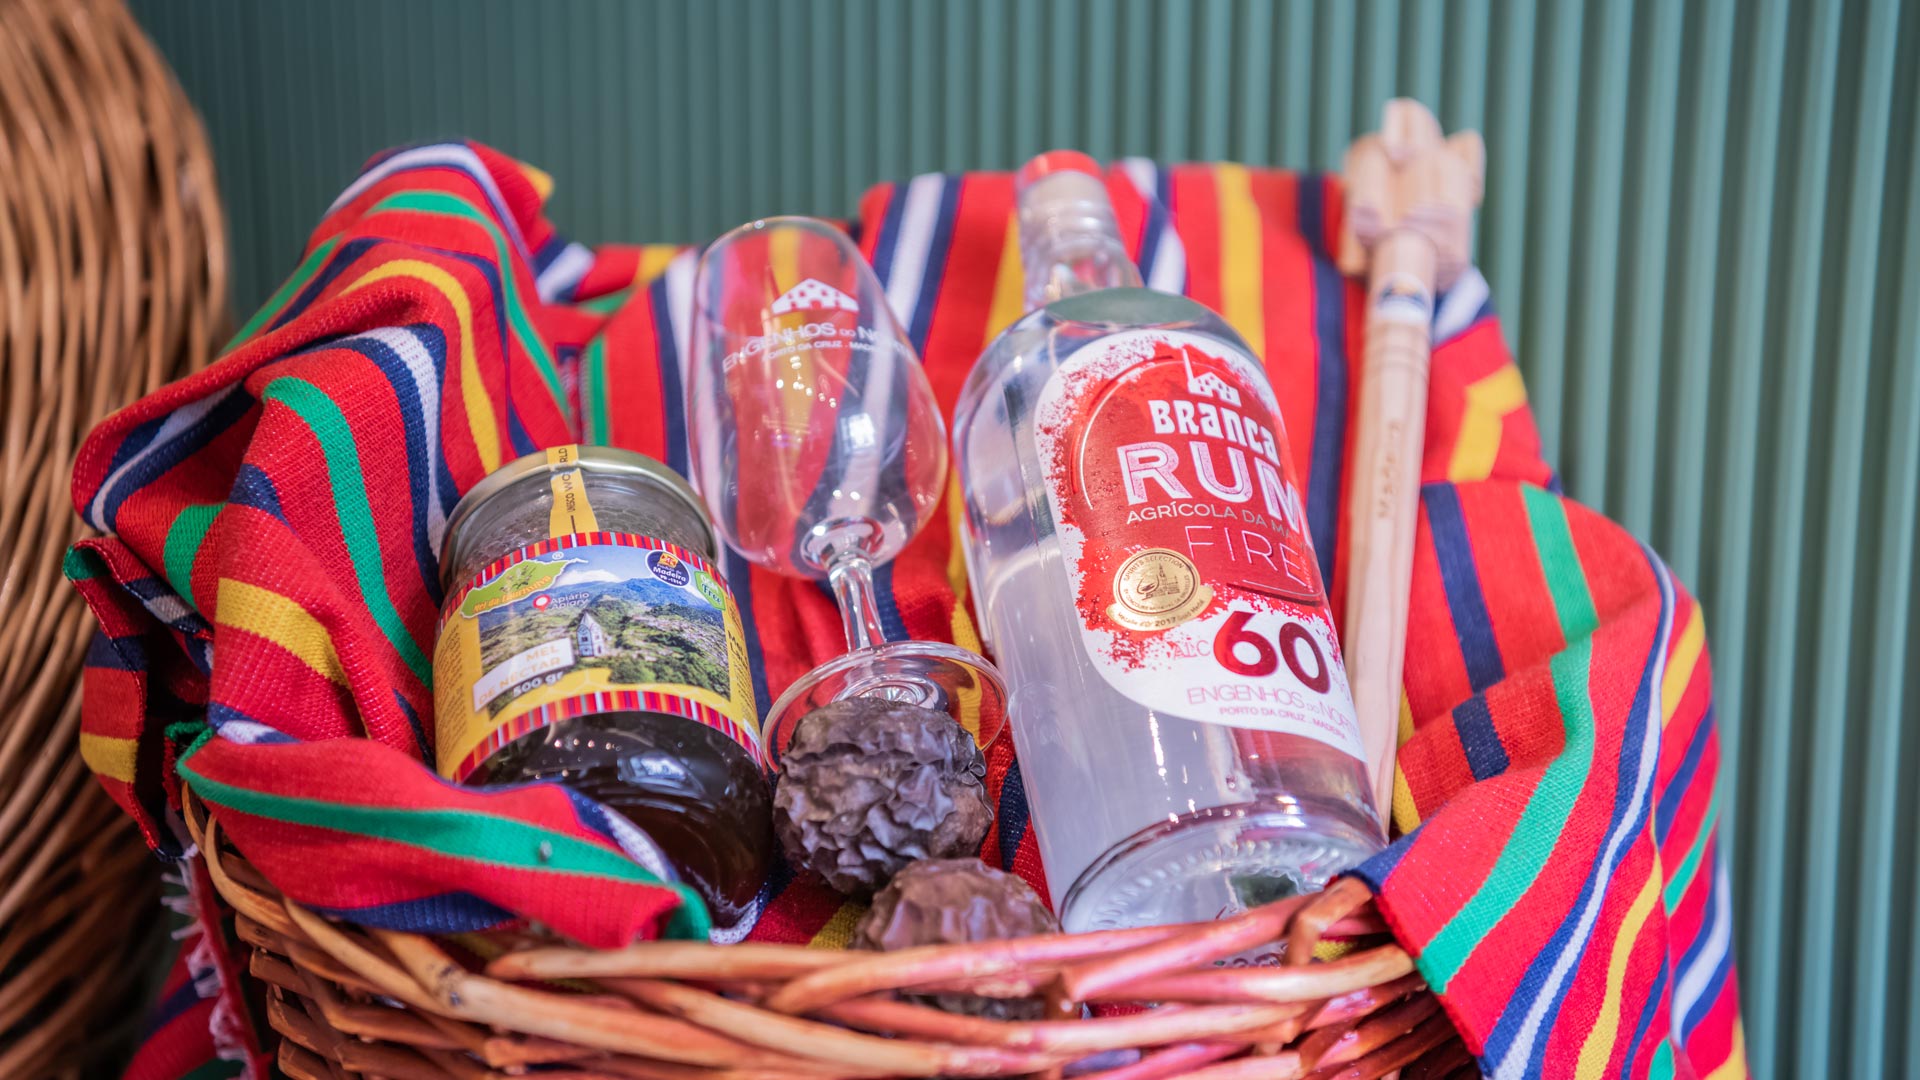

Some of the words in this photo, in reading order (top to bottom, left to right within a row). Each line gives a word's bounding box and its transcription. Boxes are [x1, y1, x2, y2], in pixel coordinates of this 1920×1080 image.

[1116, 440, 1314, 551] RUM
[1126, 501, 1238, 525] AGRÍCOLA
[1242, 509, 1268, 527] DA
[1185, 525, 1308, 588] FIRE
[653, 567, 687, 582] Madeira
[702, 583, 722, 605] Free
[1155, 616, 1176, 627] 2017
[526, 644, 559, 661] MEL
[1213, 610, 1331, 695] 60
[513, 676, 542, 697] 500
[545, 671, 564, 687] gr
[1187, 683, 1306, 709] ENGENHOS
[1219, 706, 1260, 716] PORTO
[1261, 707, 1276, 717] DA
[1277, 709, 1306, 724] CRUZ
